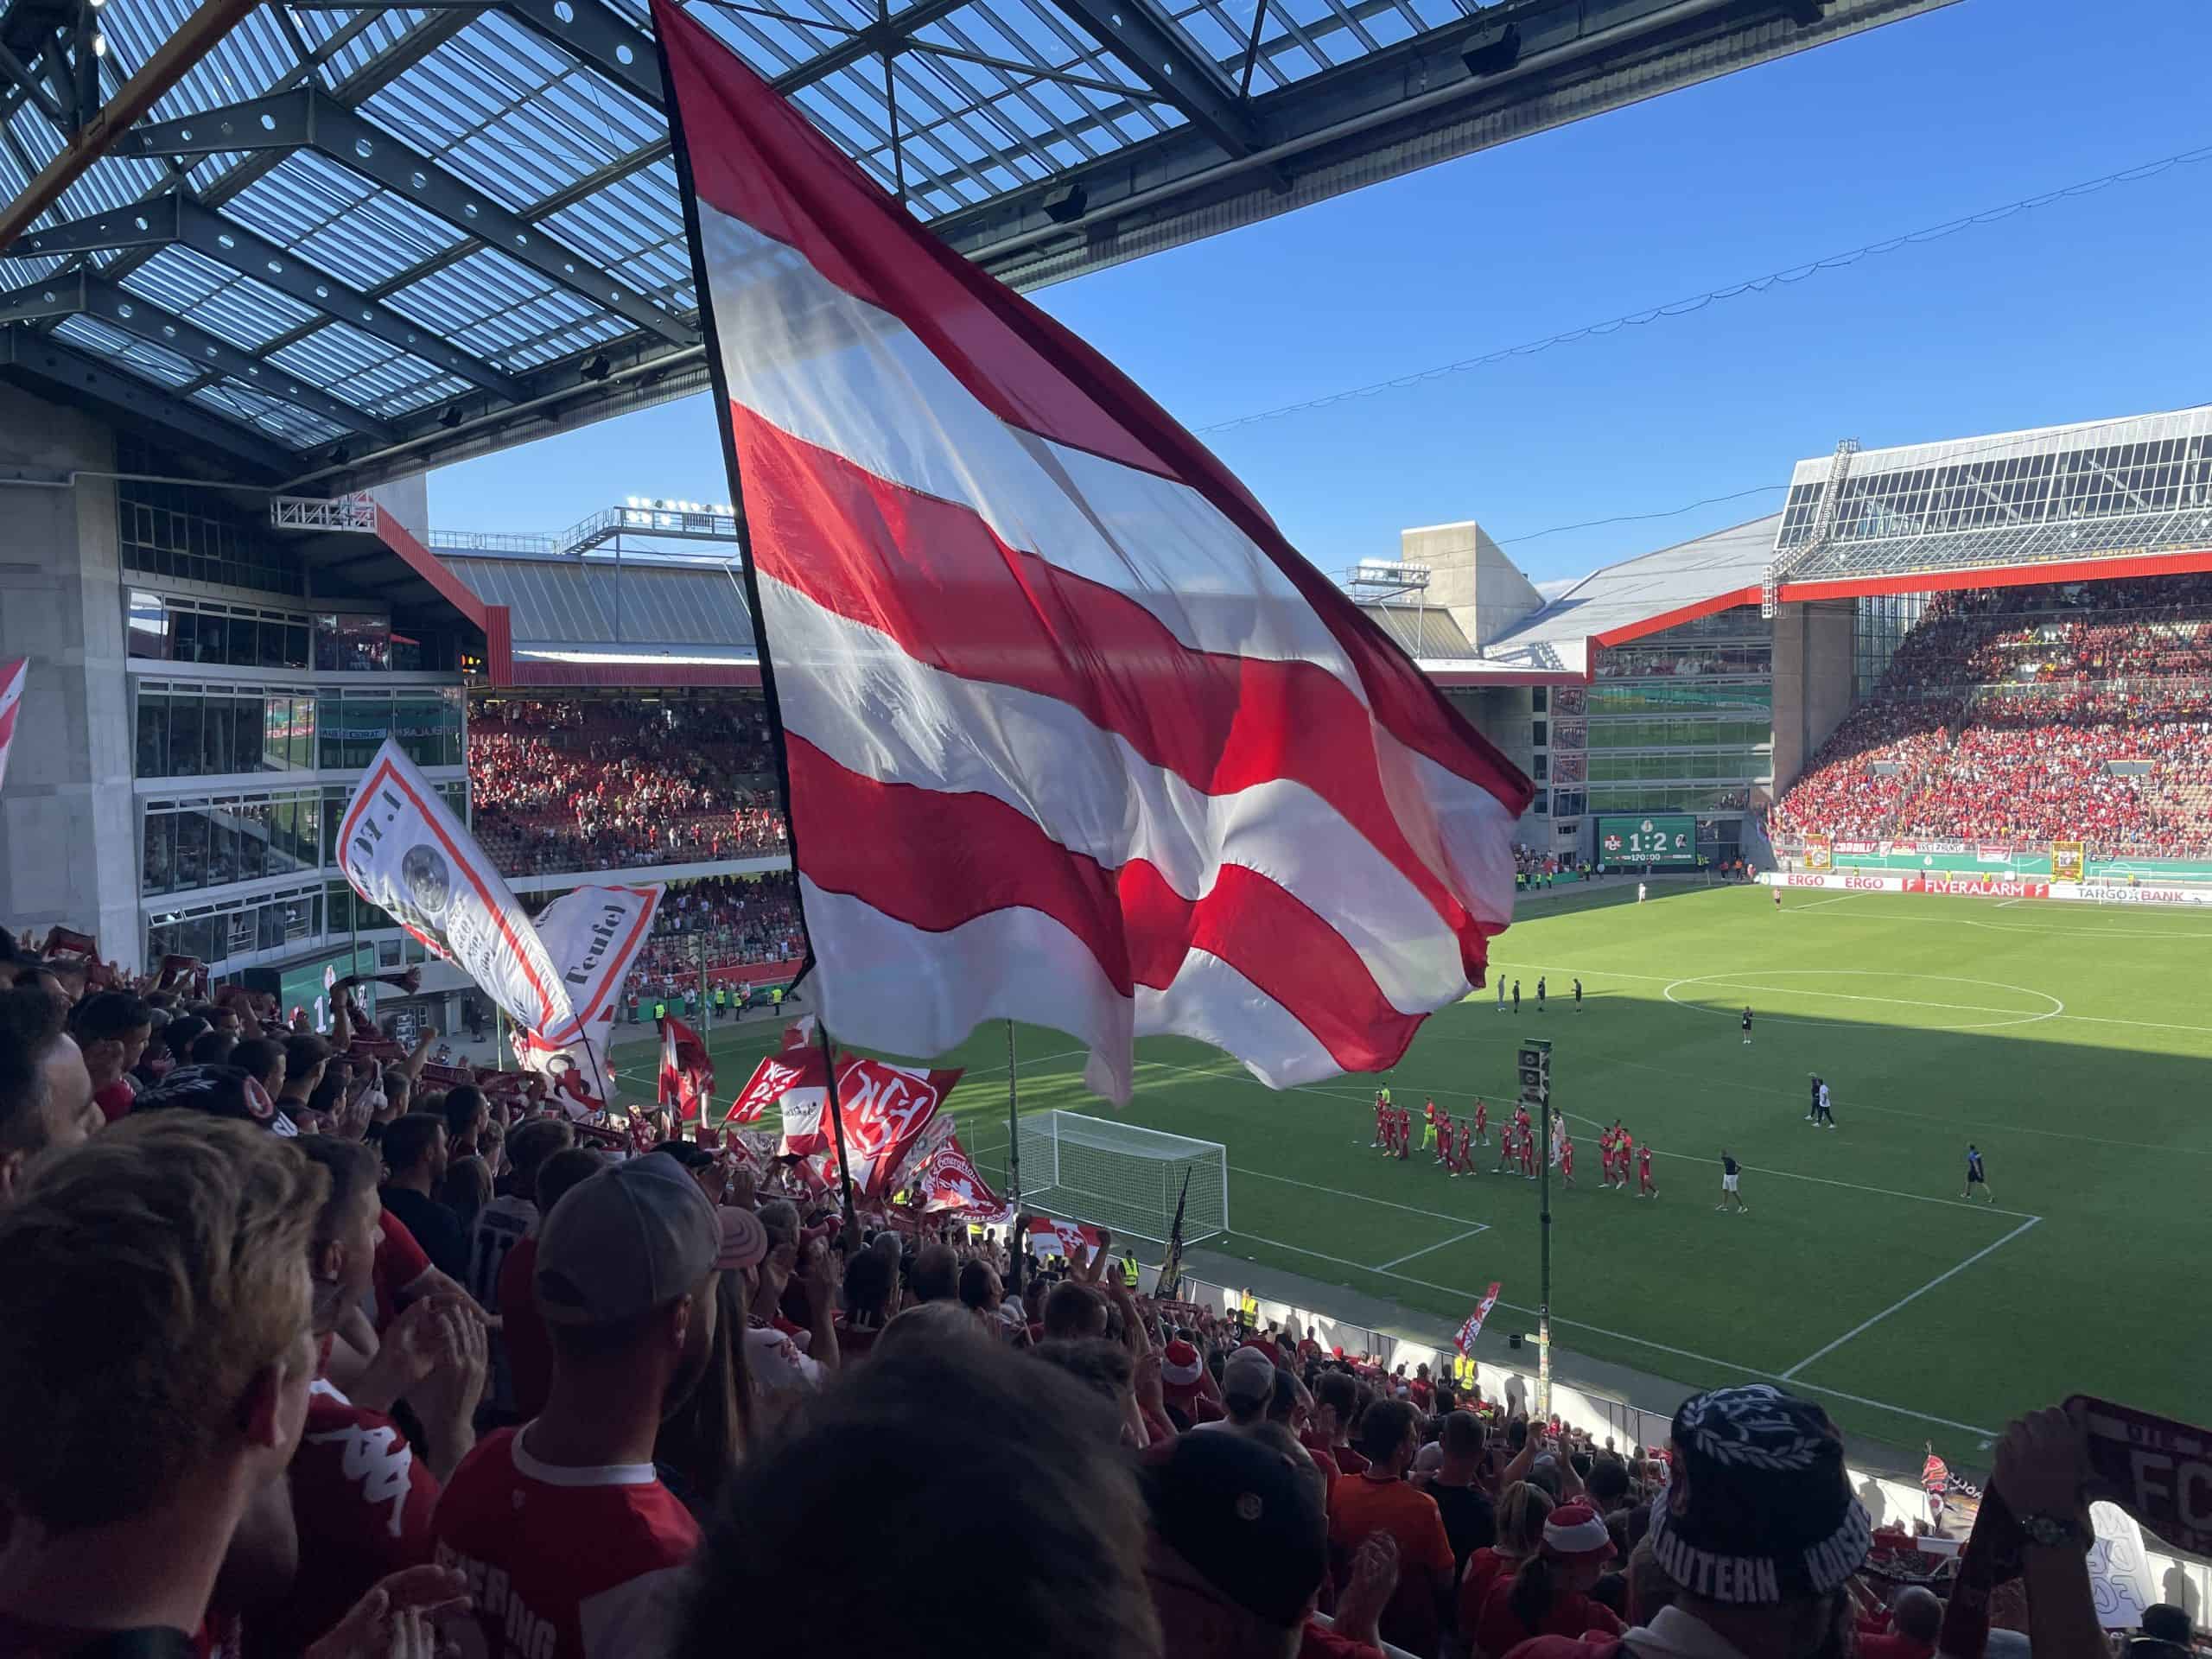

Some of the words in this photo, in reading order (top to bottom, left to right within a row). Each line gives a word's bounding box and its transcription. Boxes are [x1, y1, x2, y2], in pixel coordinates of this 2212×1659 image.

[1630, 832, 1667, 852] 1:2
[1788, 875, 1824, 886] ERGO
[1846, 877, 1884, 889] ERGO
[1925, 879, 2024, 897] FLYERALARM
[565, 904, 627, 985] Teufel
[2130, 1450, 2212, 1536] FC
